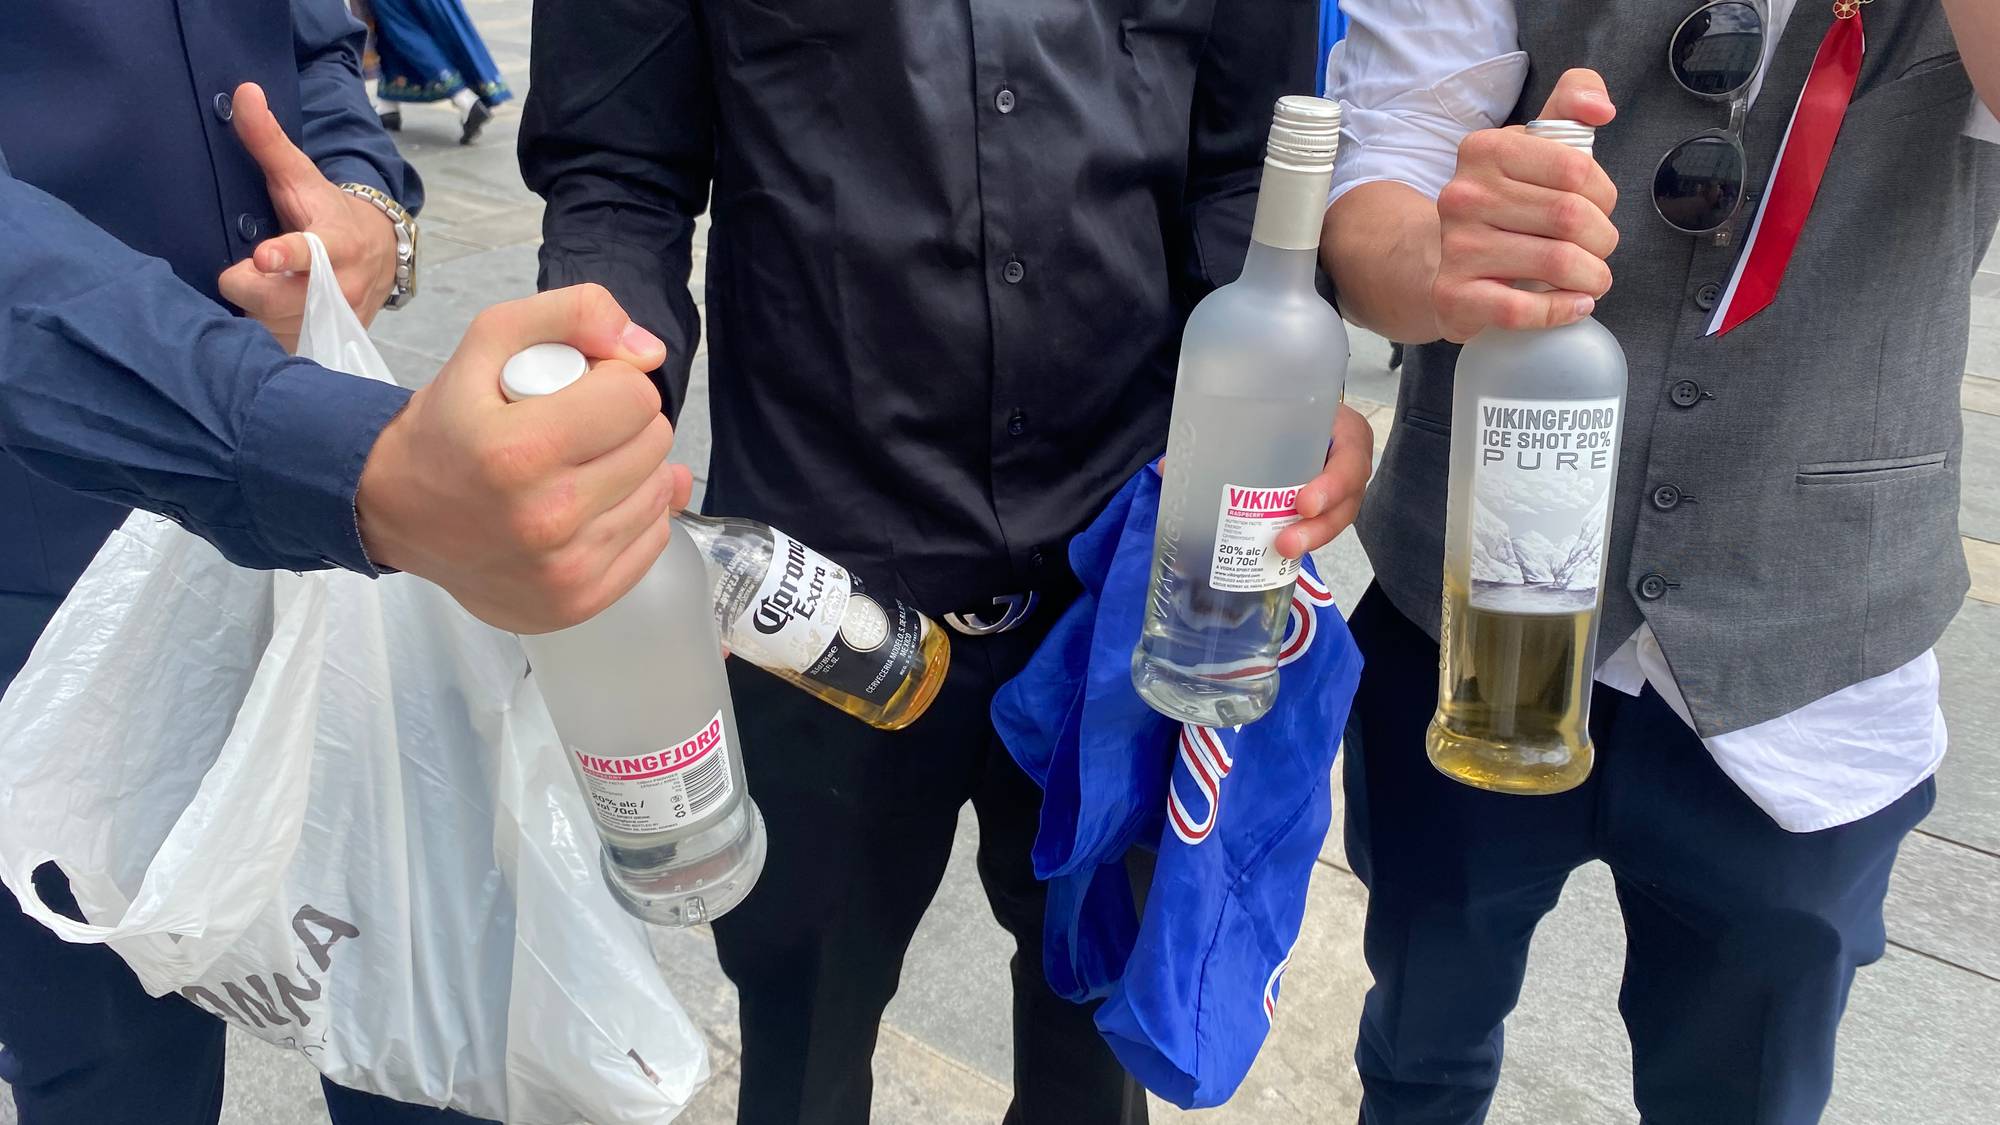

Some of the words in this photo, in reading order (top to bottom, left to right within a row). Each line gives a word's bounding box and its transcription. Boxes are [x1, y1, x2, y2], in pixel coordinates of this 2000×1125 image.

[1483, 406, 1614, 430] VIKINGFJORD
[1483, 430, 1511, 448] ICE
[1518, 432, 1572, 450] SHOT
[1576, 430, 1610, 448] 20%
[1483, 448, 1607, 470] PURE
[1229, 510, 1264, 518] RASPBERRY
[1218, 556, 1233, 565] vol
[1237, 558, 1258, 566] 70cl
[1220, 544, 1243, 556] 20%
[1246, 548, 1260, 556] alc
[753, 540, 805, 634] Corona
[792, 566, 826, 620] Extra
[900, 633, 912, 657] MEXICO
[866, 660, 894, 693] CERVECERIA
[576, 719, 720, 774] VIKINGFJORD
[592, 792, 616, 806] 20%
[620, 800, 637, 808] alc
[612, 806, 638, 815] 70cl
